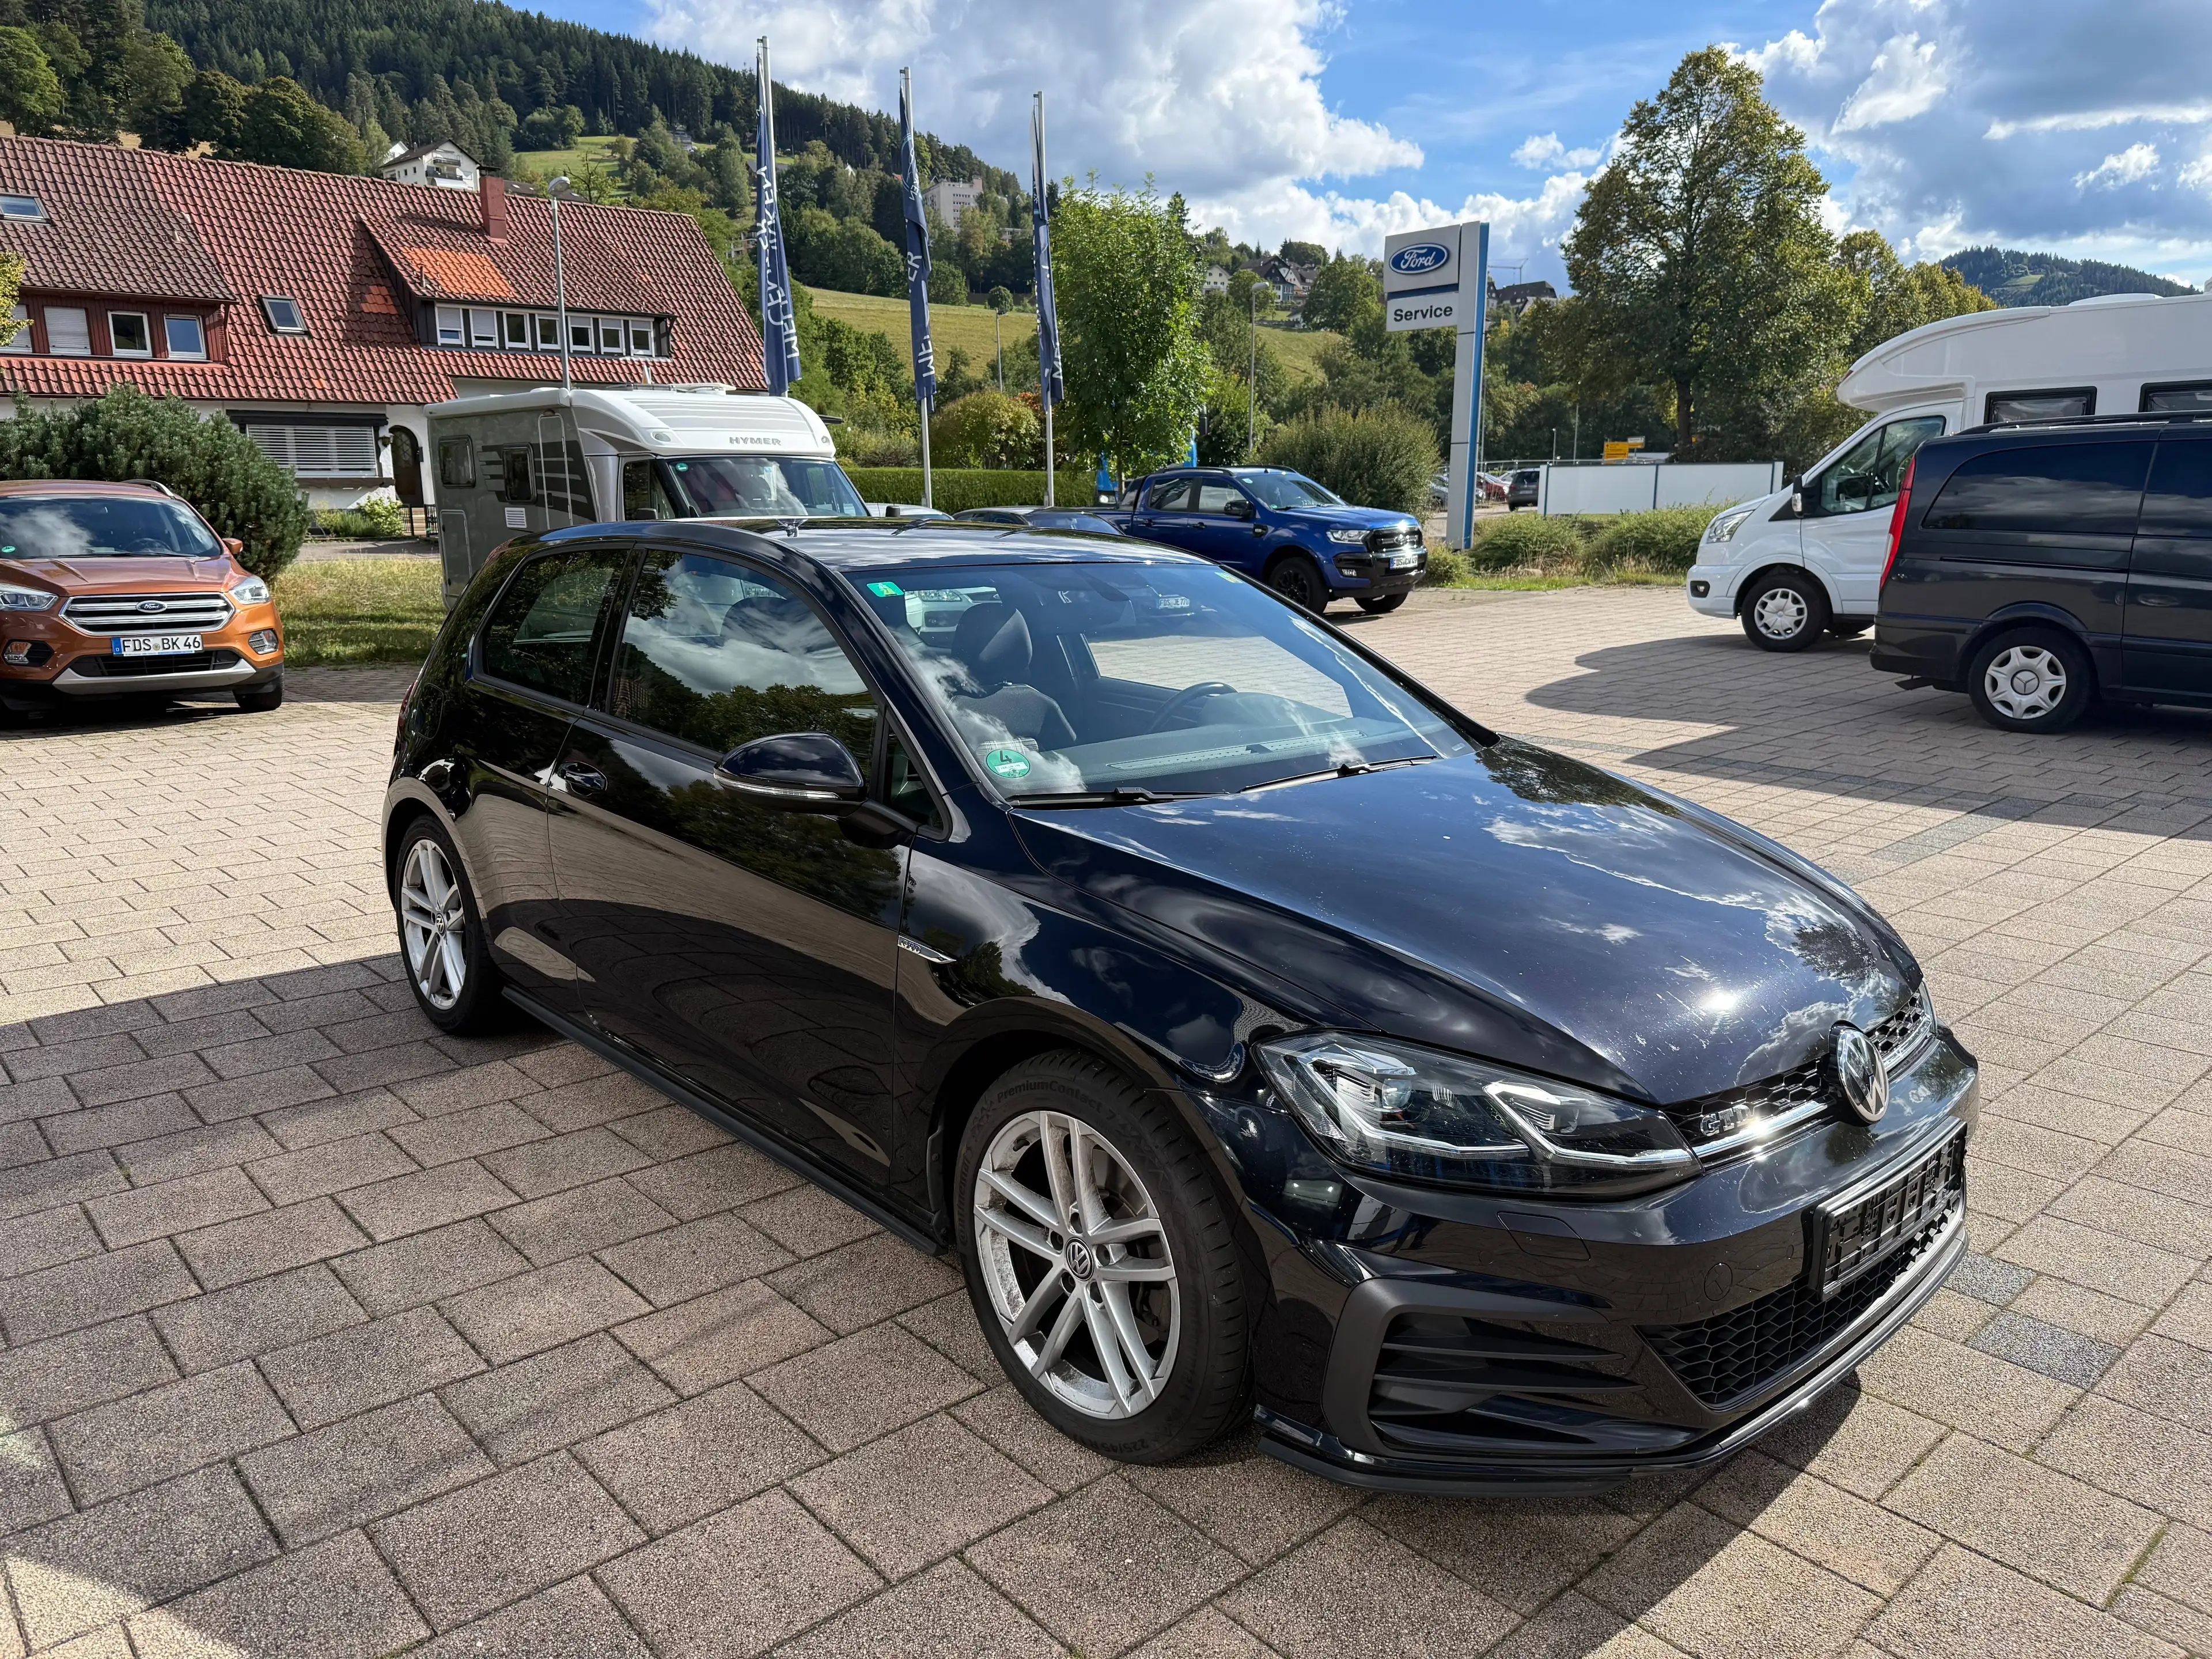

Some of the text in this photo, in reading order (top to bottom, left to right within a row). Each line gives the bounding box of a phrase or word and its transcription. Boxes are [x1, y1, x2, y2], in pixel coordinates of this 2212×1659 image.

[1400, 248, 1436, 270] Ford
[1393, 305, 1453, 323] Service
[729, 437, 781, 446] HYMER
[122, 637, 200, 652] FDS BK 46
[999, 750, 1013, 763] 4
[997, 1080, 1103, 1113] PremiumContact
